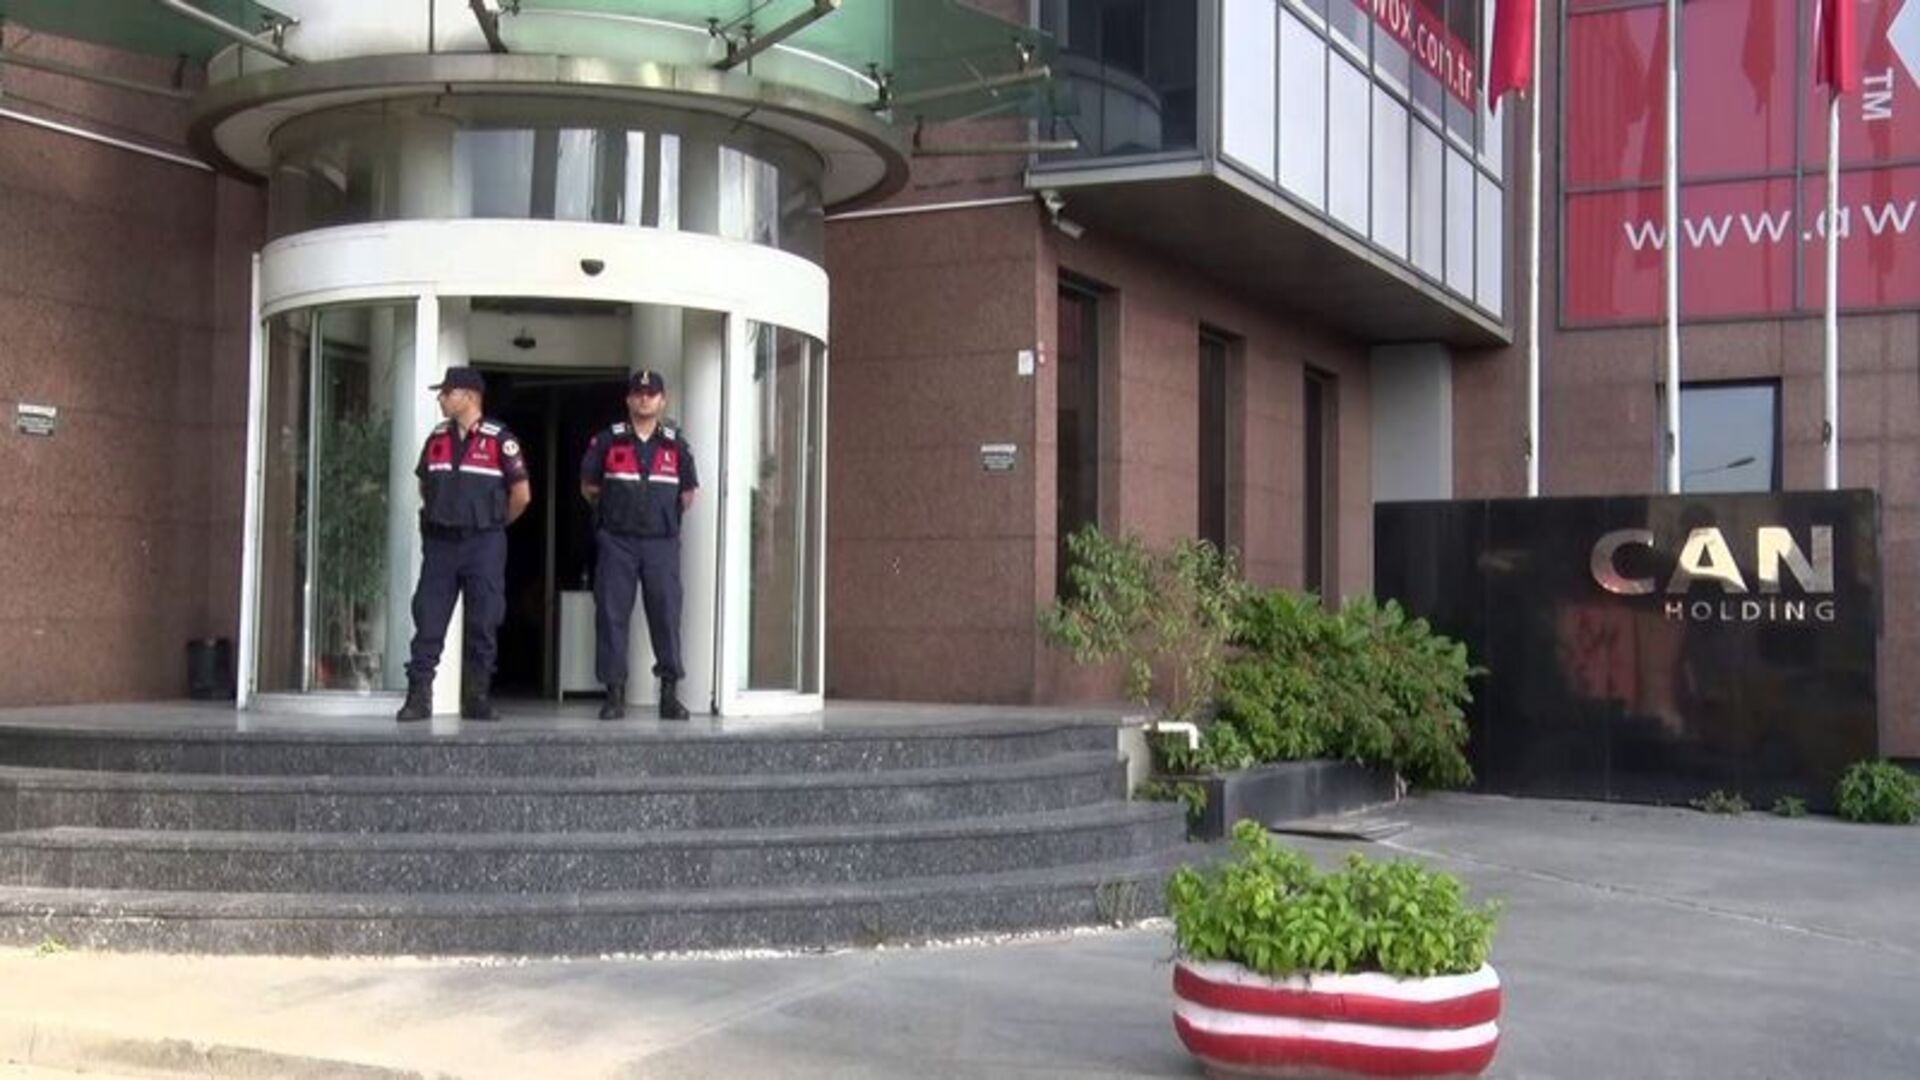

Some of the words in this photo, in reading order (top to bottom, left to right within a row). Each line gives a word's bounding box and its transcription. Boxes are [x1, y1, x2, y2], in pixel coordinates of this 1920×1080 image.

[1363, 0, 1472, 101] wox.com.tr
[1862, 67, 1893, 121] TM
[1590, 525, 1835, 595] CAN
[1664, 597, 1836, 621] HOLDİNG
